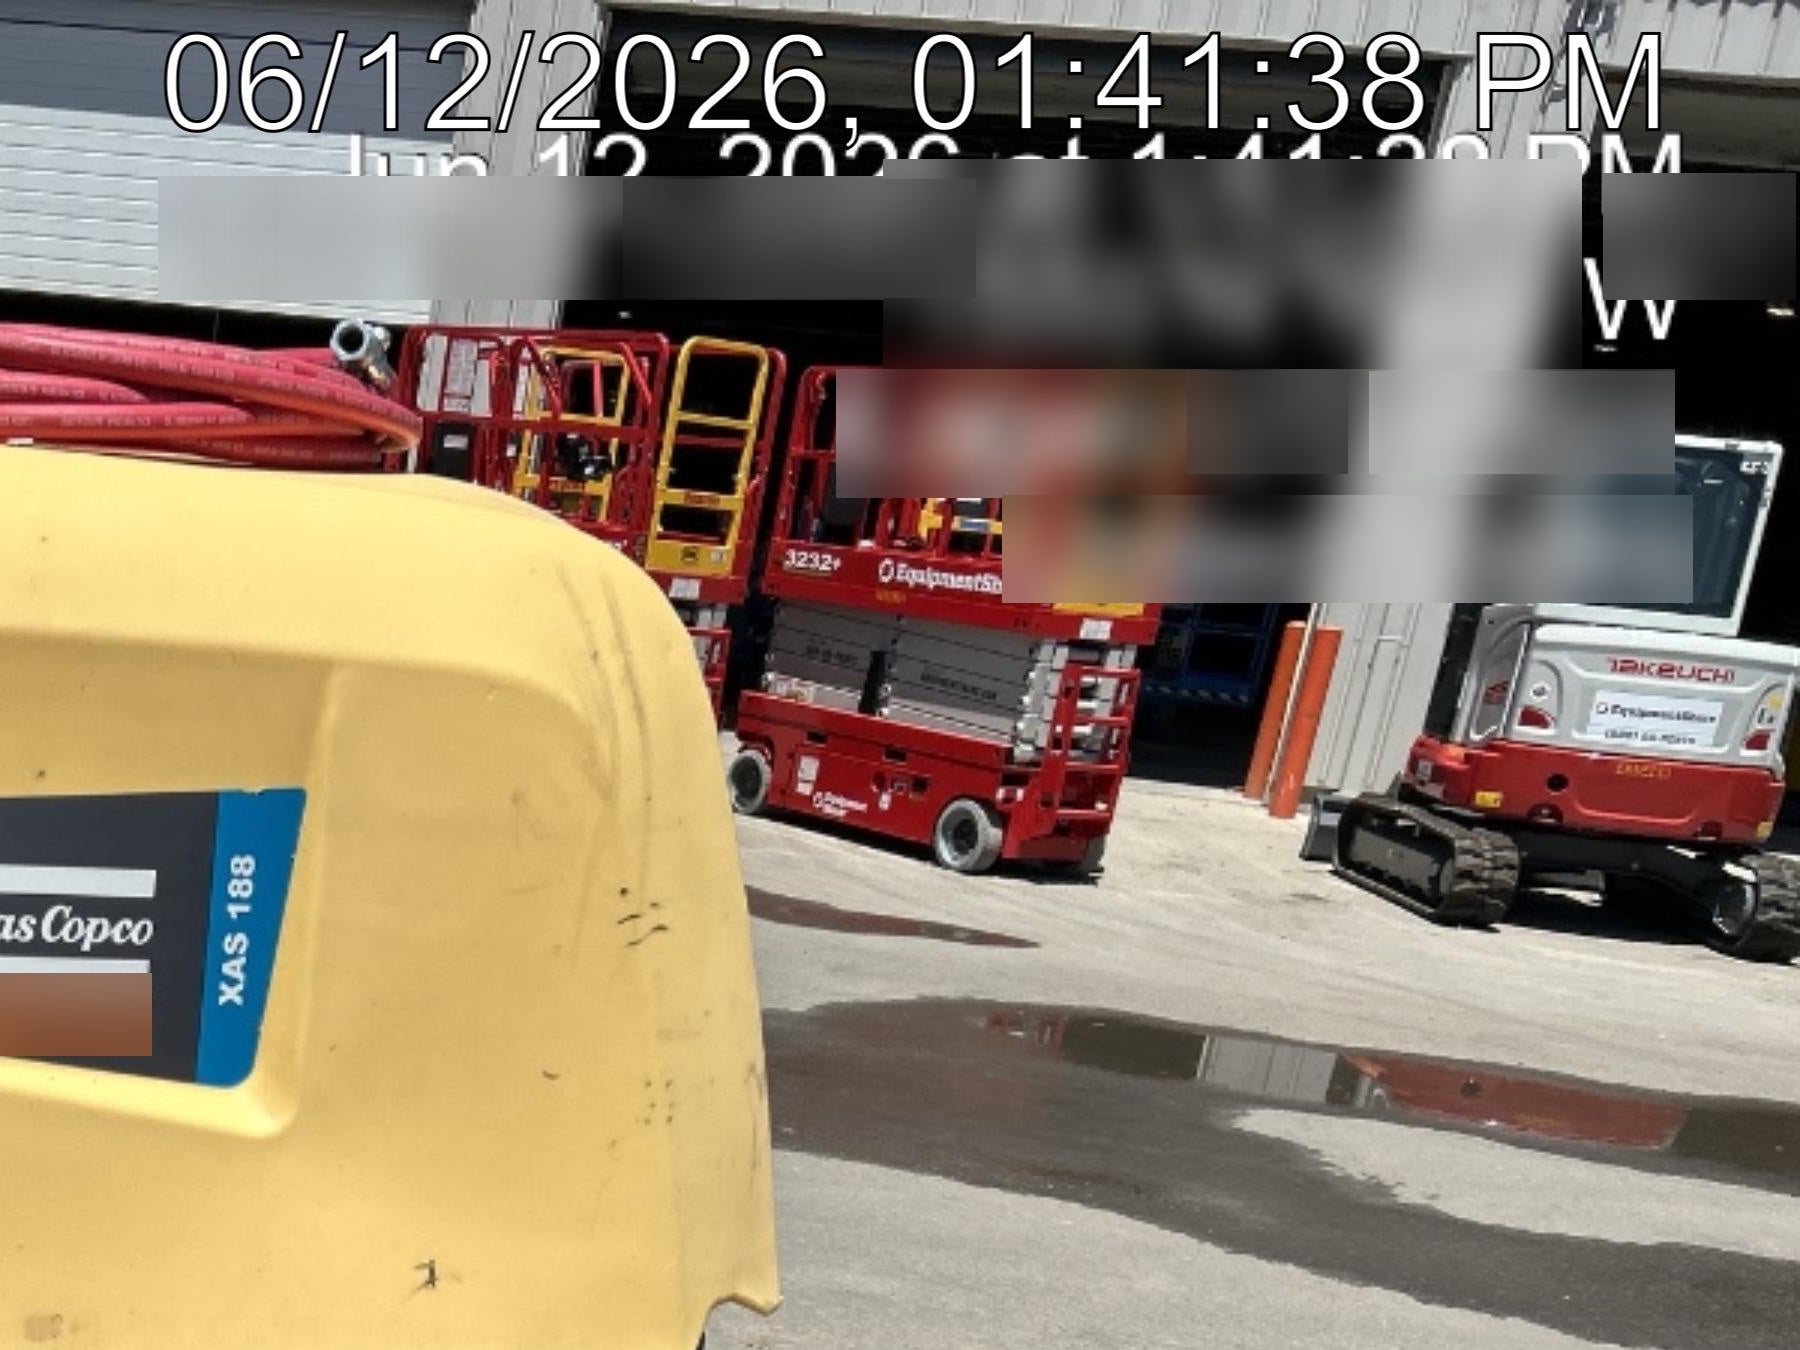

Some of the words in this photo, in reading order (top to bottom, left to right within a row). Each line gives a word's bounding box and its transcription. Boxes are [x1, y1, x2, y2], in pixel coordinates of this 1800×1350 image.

[783, 549, 841, 572] 3232+
[895, 563, 1002, 594] EquipmentSh
[226, 854, 257, 920] 188
[40, 904, 154, 952] Copco
[217, 933, 251, 1007] XAS
